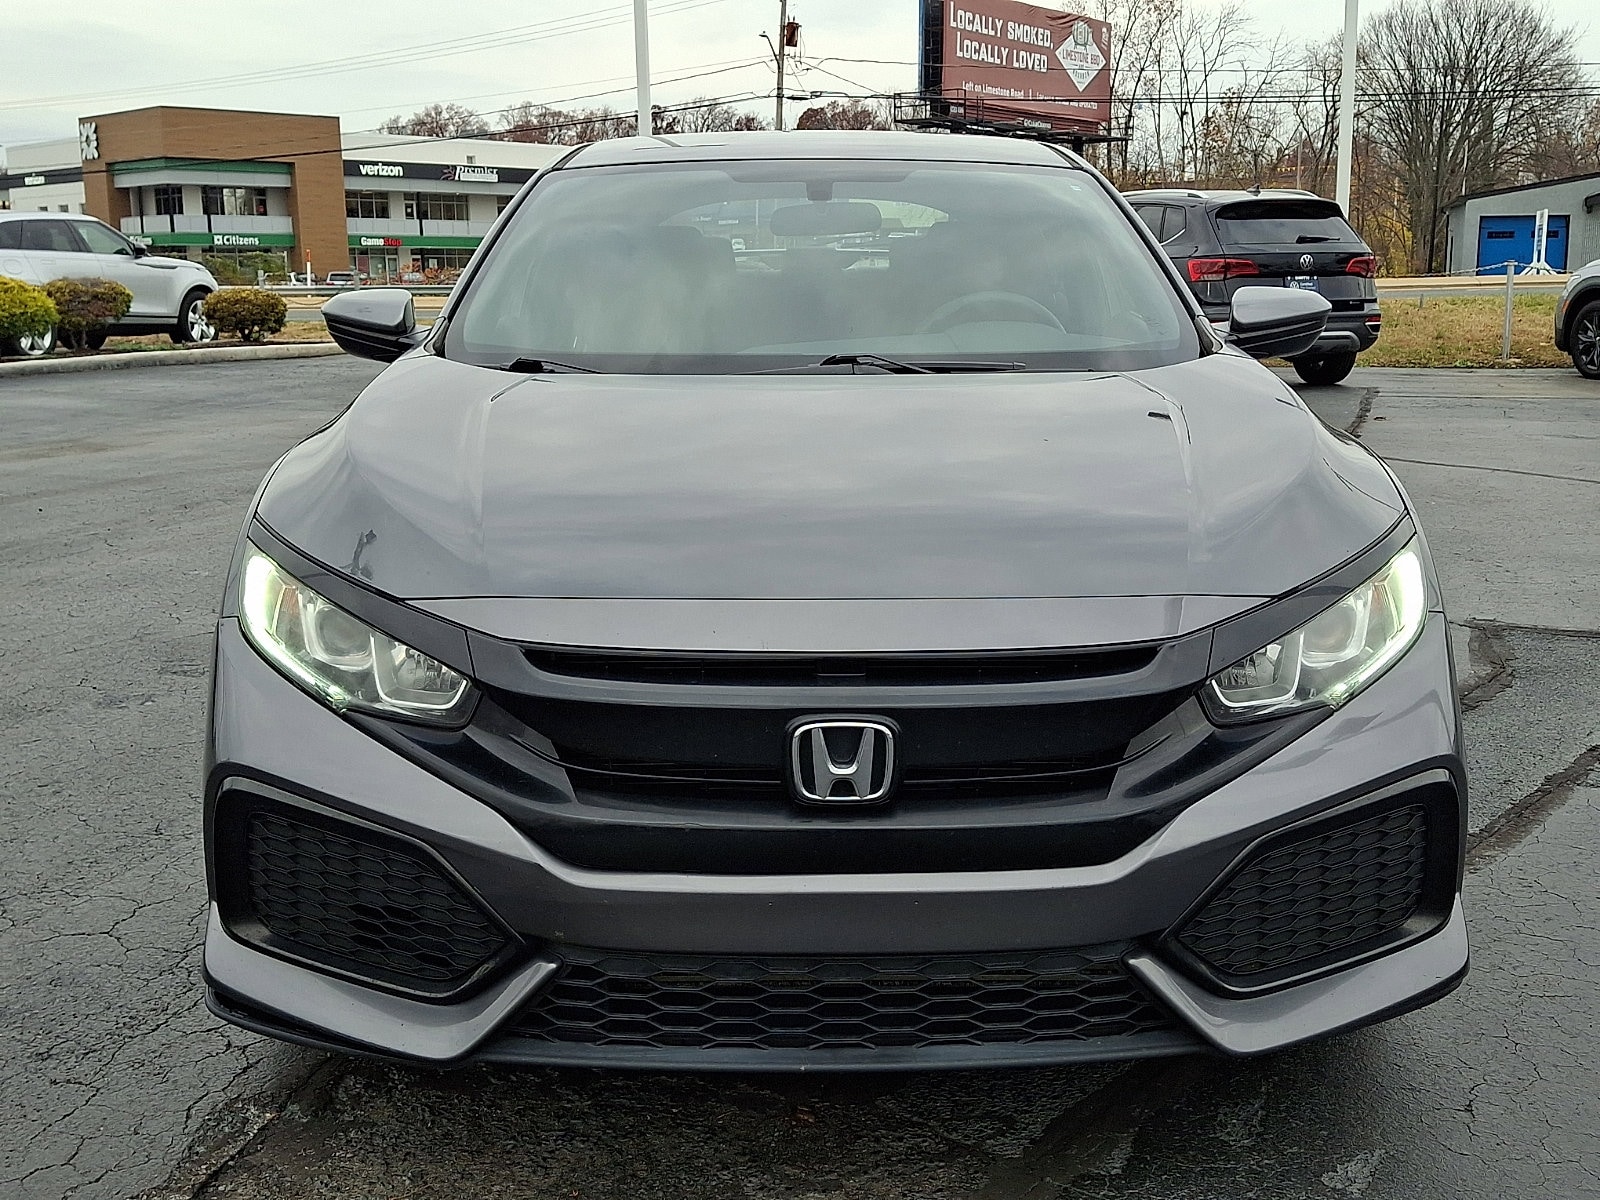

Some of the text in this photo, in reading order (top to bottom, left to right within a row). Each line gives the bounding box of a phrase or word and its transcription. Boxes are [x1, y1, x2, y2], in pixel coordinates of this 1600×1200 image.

[1012, 49, 1048, 73] LOVED
[962, 80, 974, 92] Left
[974, 84, 982, 93] on
[982, 83, 1010, 97] Limestone
[1010, 88, 1024, 99] Road
[359, 162, 404, 177] verizon
[454, 165, 498, 181] Premier
[223, 235, 260, 246] Citizens
[360, 236, 403, 248] GameStop
